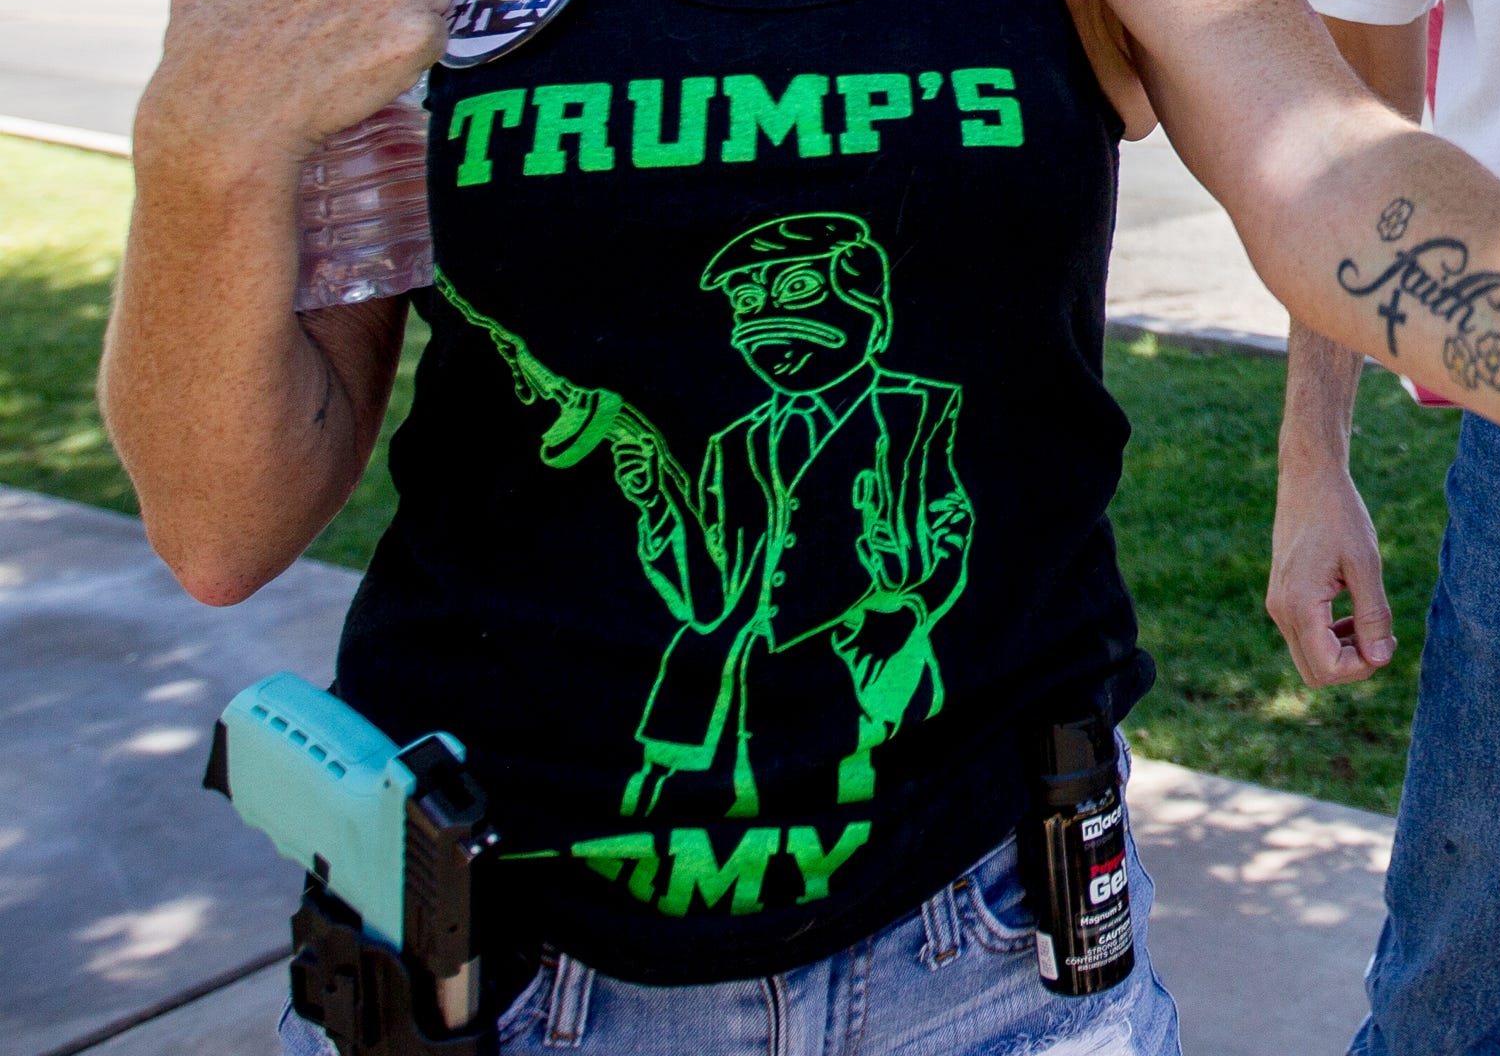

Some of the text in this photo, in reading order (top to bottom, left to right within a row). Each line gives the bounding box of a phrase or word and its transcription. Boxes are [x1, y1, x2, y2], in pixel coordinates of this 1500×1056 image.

[447, 67, 1025, 187] TRUMP'S
[571, 821, 873, 918] RMY
[1089, 857, 1128, 905] Gel
[1080, 905, 1118, 927] Magnum
